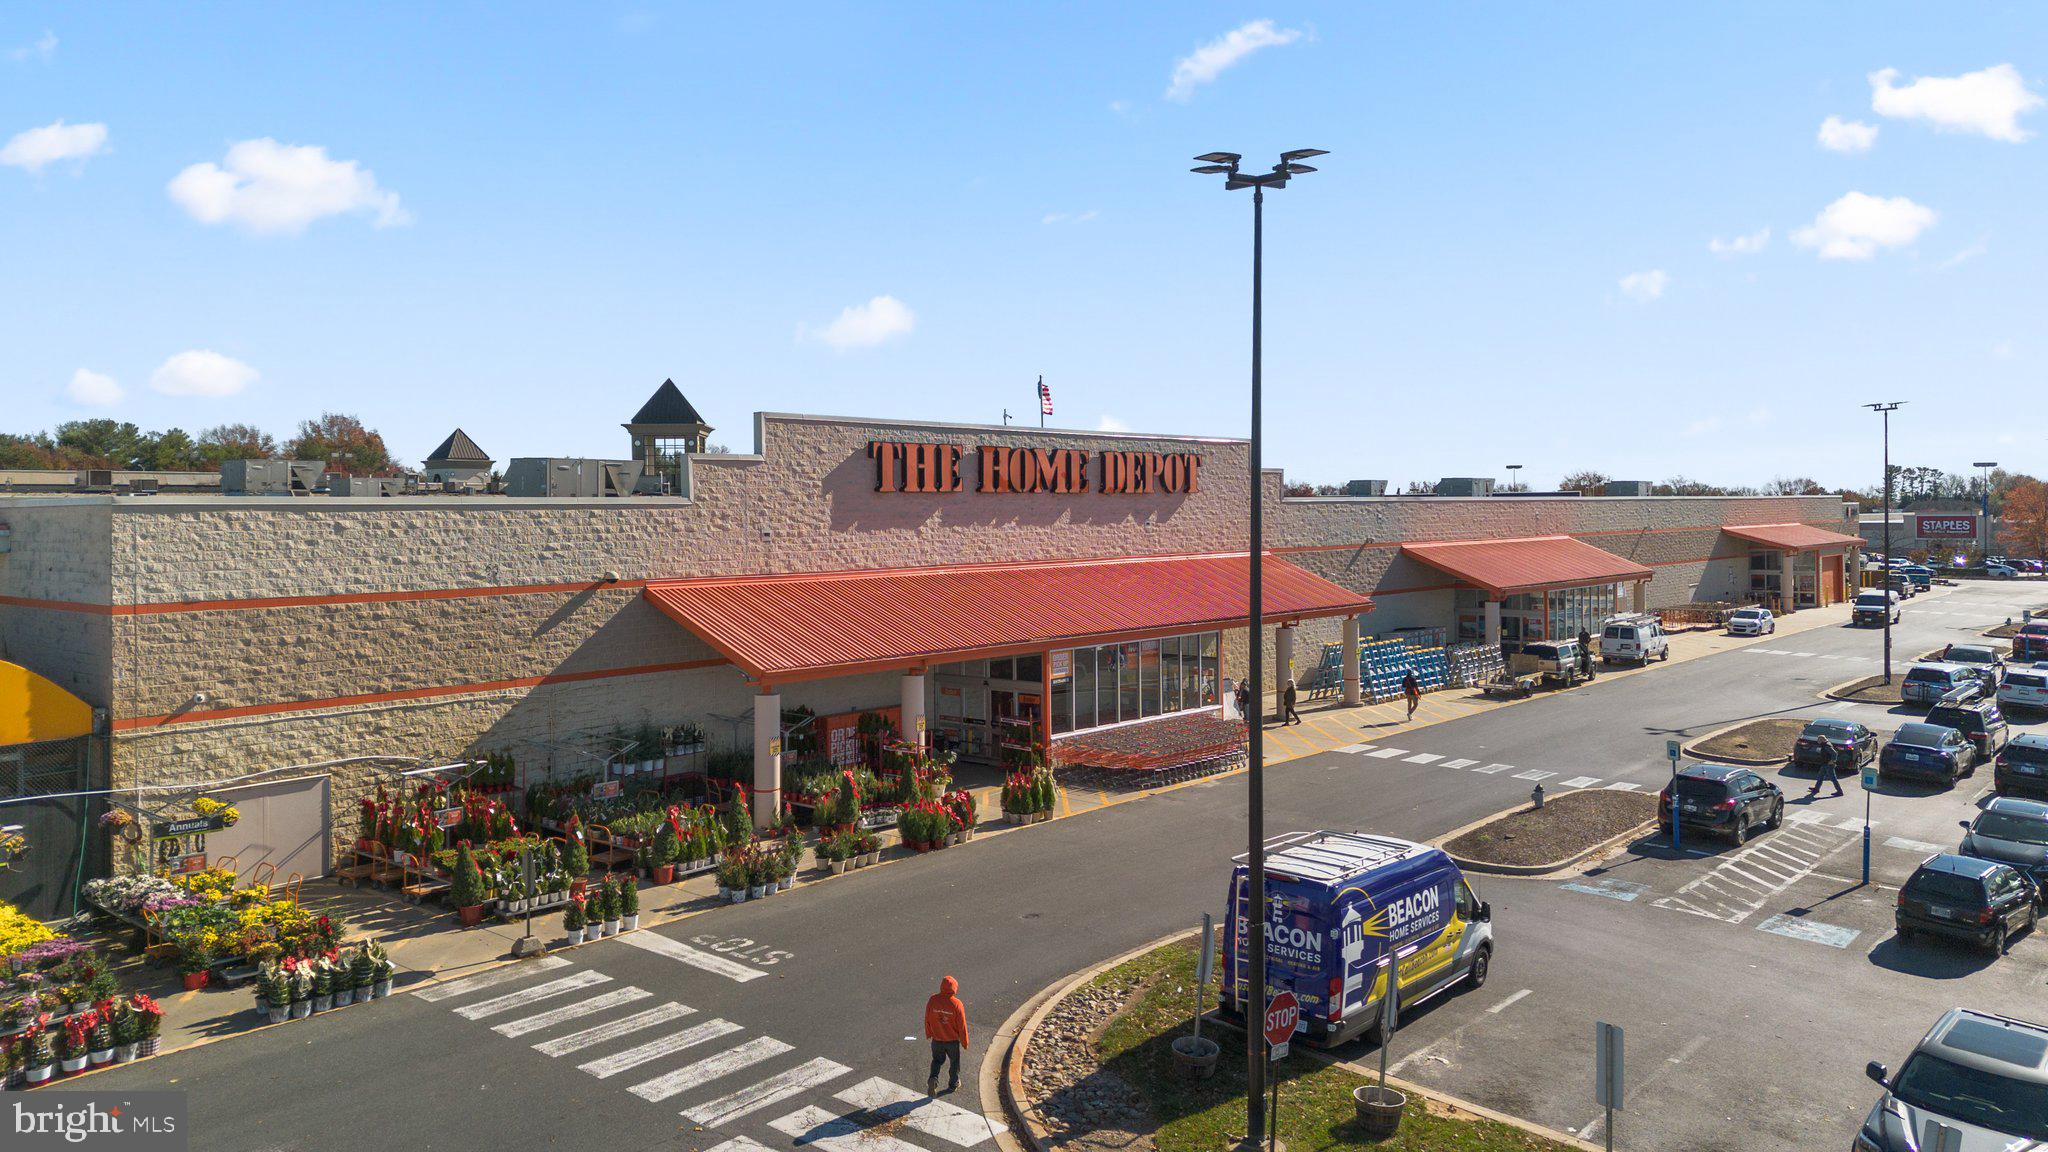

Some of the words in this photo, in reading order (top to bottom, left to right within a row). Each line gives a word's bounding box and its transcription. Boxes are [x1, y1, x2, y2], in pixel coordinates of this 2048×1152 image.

[868, 441, 964, 493] THE
[976, 445, 1090, 494] HOME
[1099, 450, 1201, 494] DEPOT
[1922, 520, 1970, 530] STAPLES
[168, 820, 209, 832] Annuals
[1388, 885, 1439, 928] BEACON
[1238, 915, 1322, 952] BACON
[1389, 923, 1410, 942] HOME
[1410, 910, 1440, 933] SERVICES
[1267, 943, 1322, 963] SERVICES
[1266, 1006, 1297, 1032] STOP
